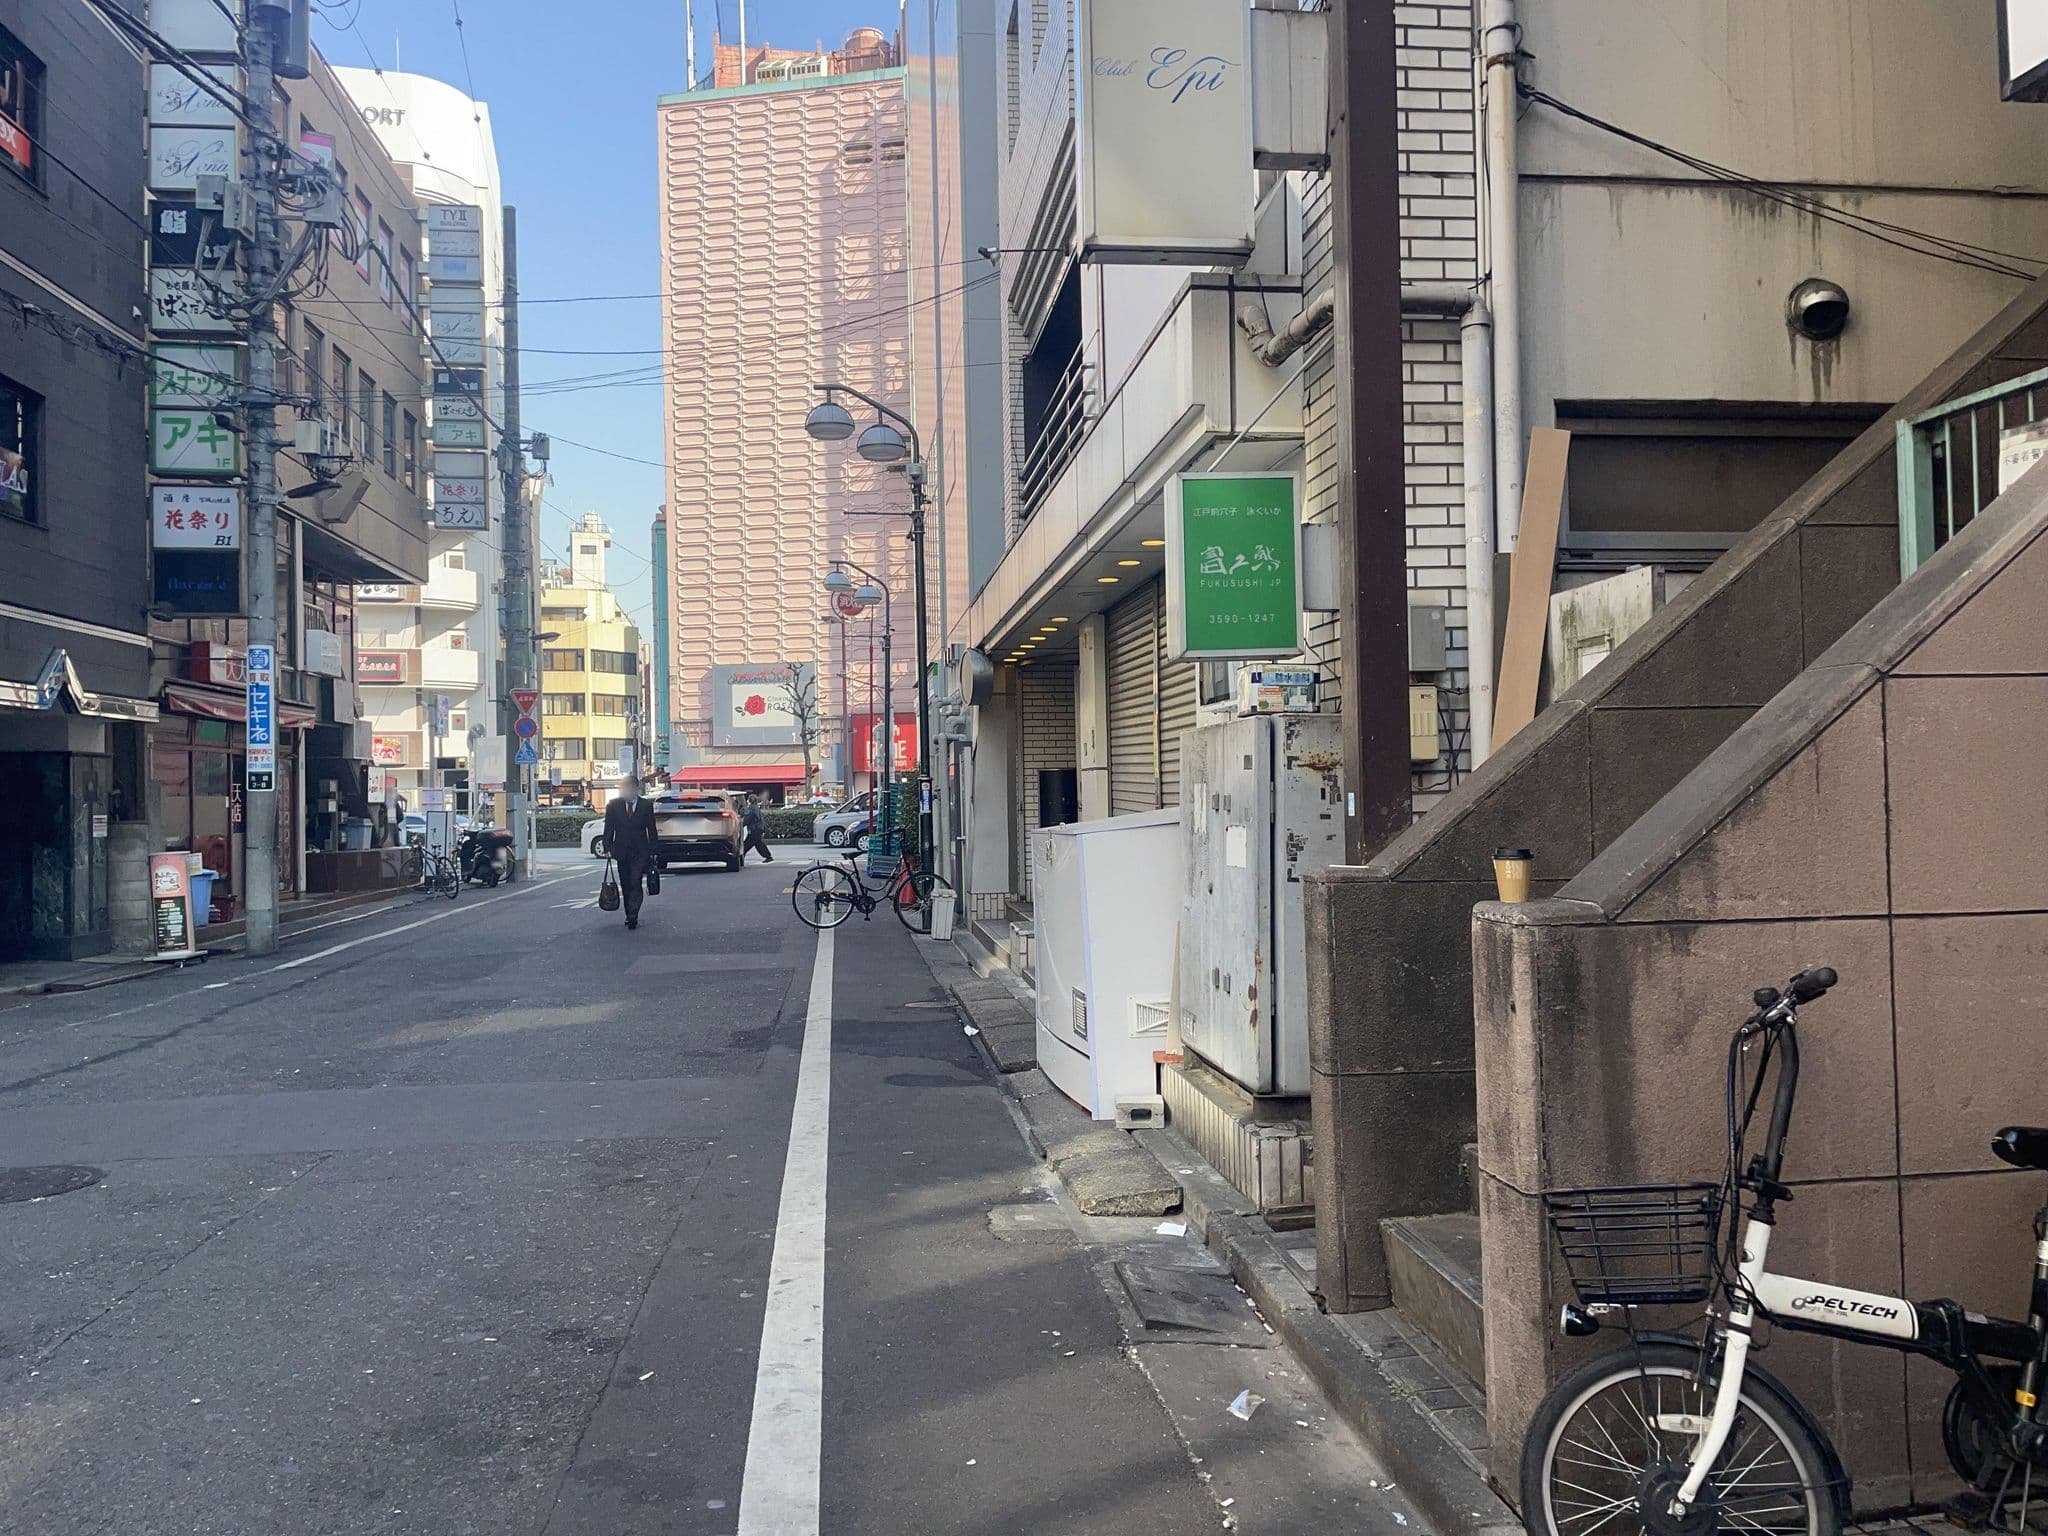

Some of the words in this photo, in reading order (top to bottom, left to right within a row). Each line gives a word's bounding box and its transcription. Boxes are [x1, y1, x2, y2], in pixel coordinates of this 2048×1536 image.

[1094, 58, 1138, 77] Club
[359, 105, 406, 126] ORT
[161, 415, 228, 454] アキ
[452, 430, 477, 441] アキ
[165, 509, 229, 530] 花祭り
[214, 535, 232, 546] B1
[1200, 579, 1263, 588] FUKUSUSHI
[1209, 613, 1276, 624] 3590-1247
[250, 687, 268, 741] セキネ
